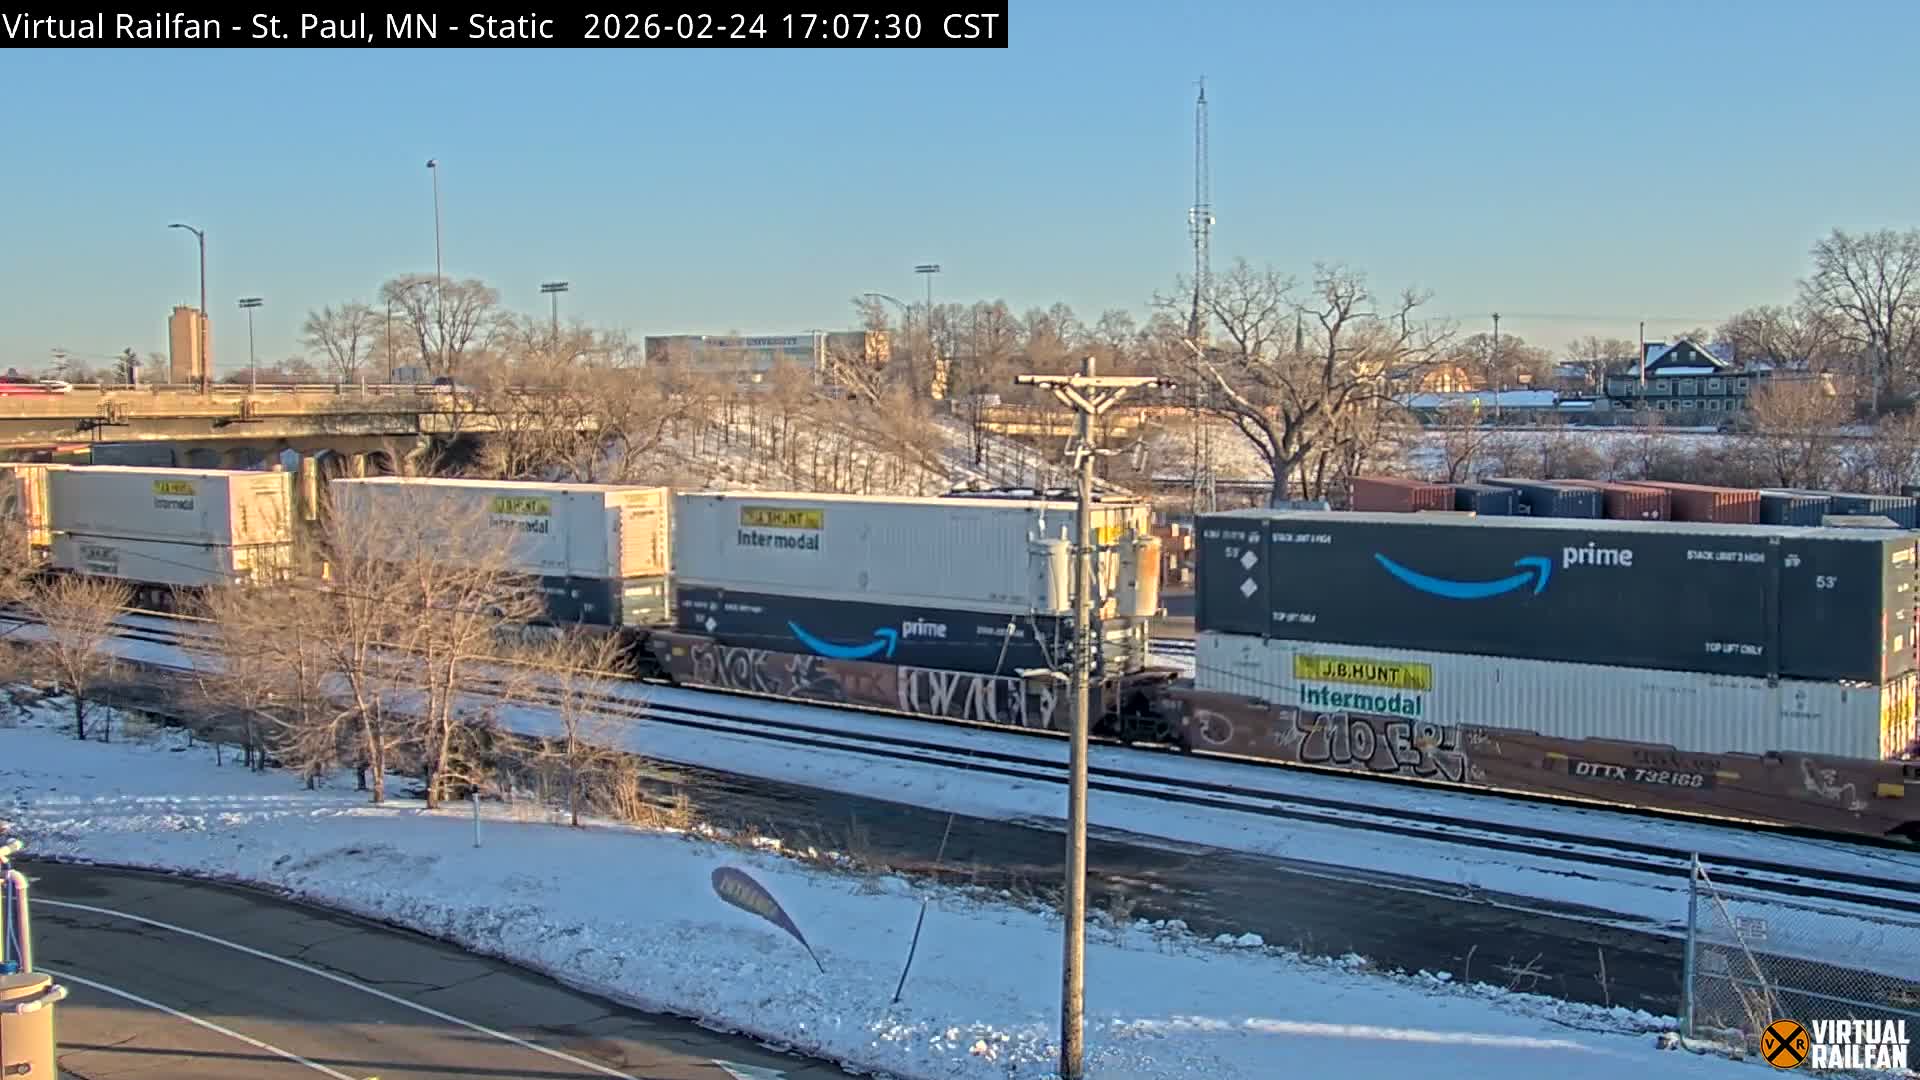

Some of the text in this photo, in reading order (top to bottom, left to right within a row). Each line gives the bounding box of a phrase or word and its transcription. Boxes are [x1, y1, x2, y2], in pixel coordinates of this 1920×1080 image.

[737, 530, 819, 551] Intermodal
[1563, 541, 1633, 568] prime
[1816, 575, 1837, 589] 53'
[903, 617, 947, 638] prime
[1322, 661, 1400, 683] J.B.HUNT
[1300, 683, 1421, 716] Intermodal
[1576, 762, 1626, 780] DTTX
